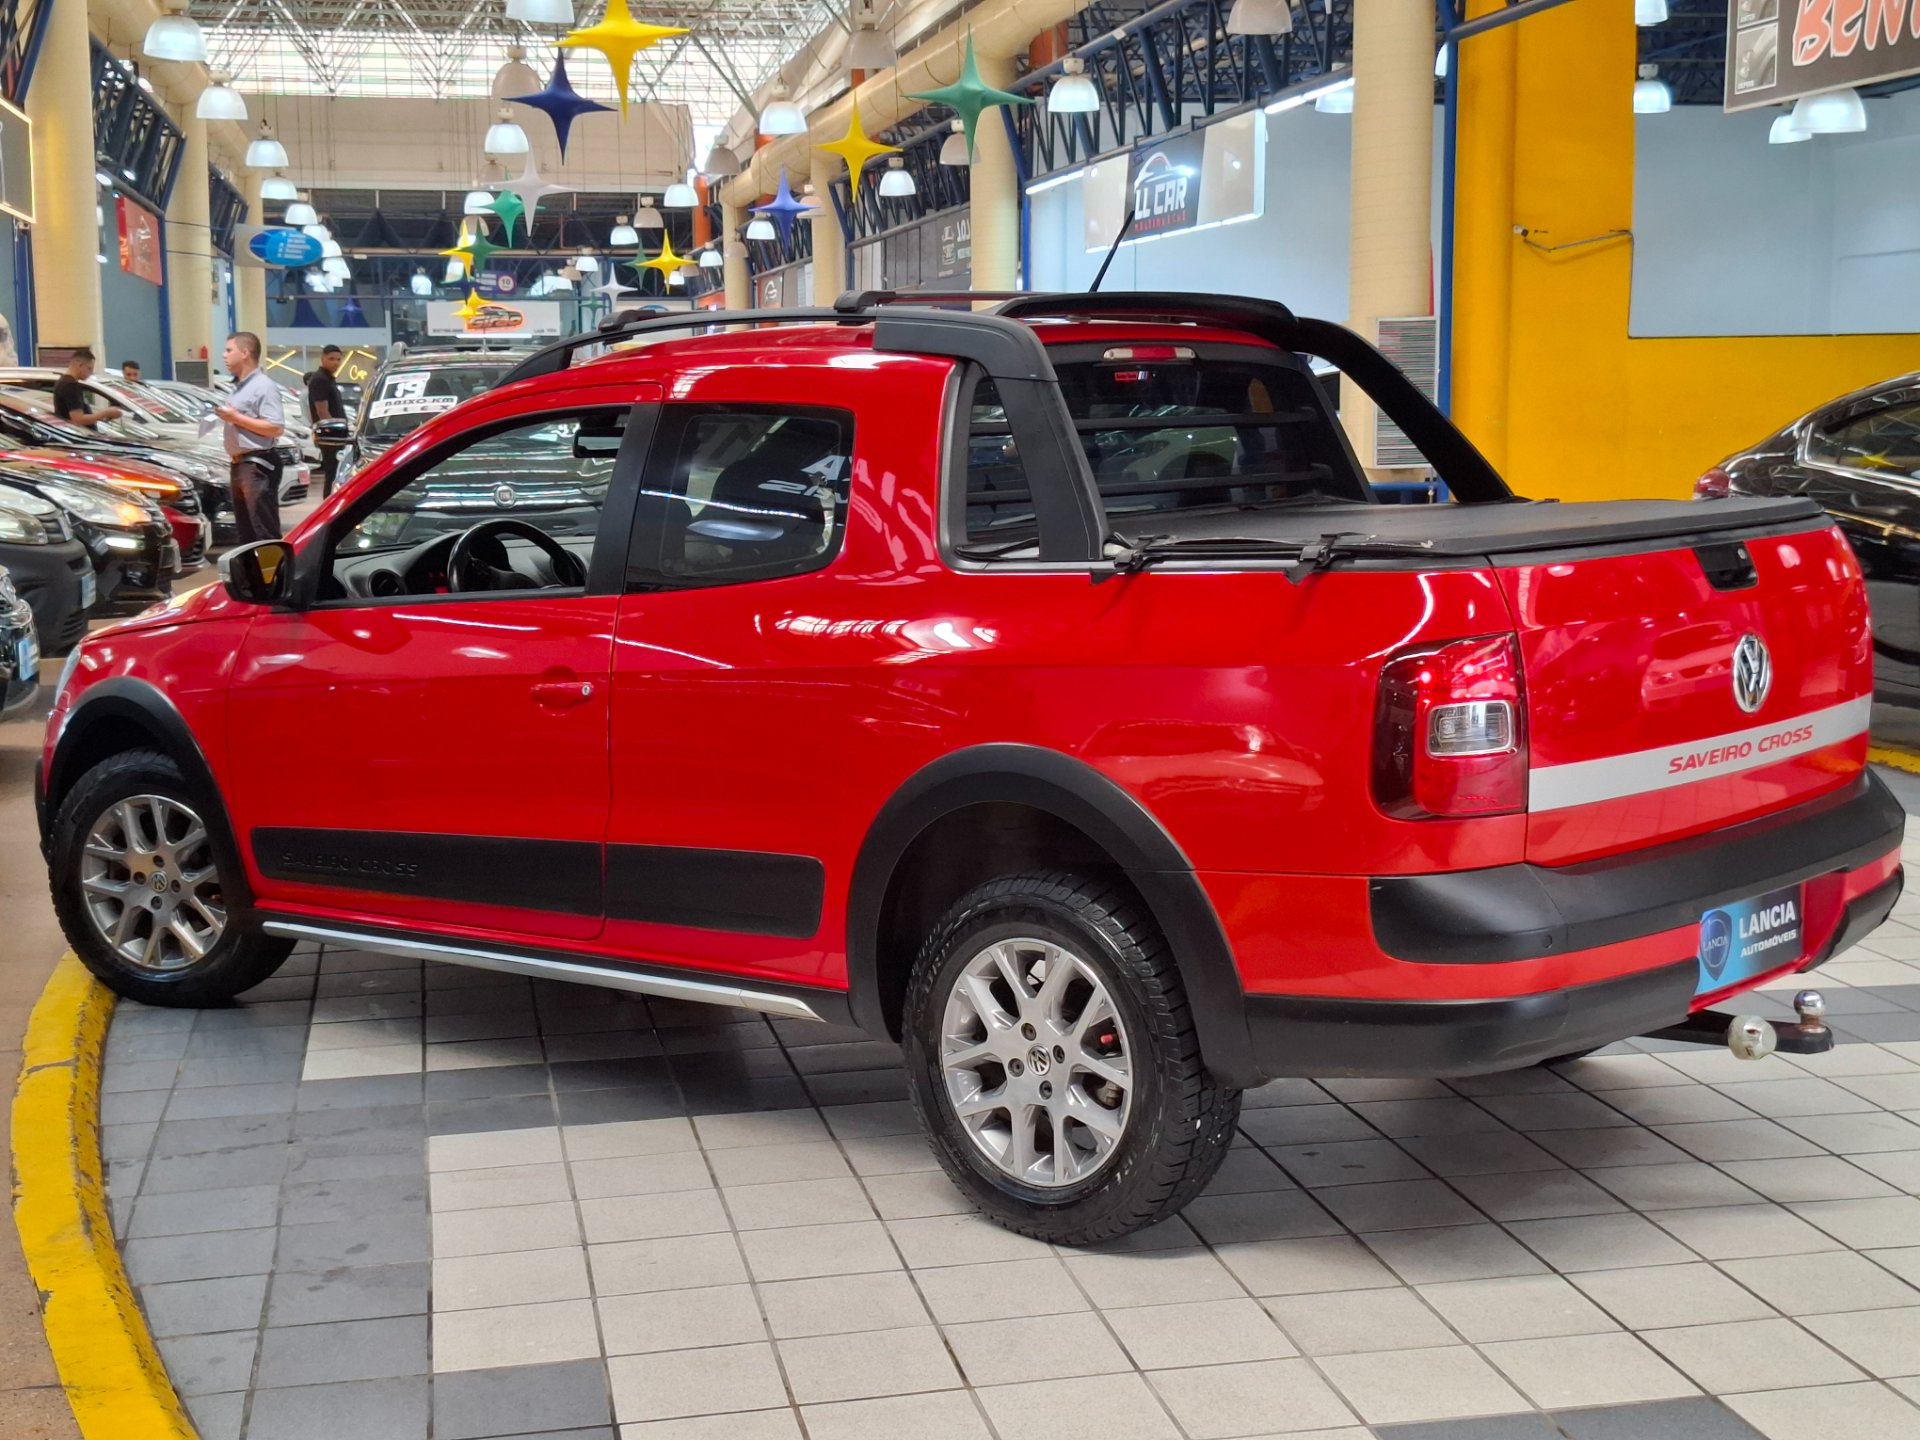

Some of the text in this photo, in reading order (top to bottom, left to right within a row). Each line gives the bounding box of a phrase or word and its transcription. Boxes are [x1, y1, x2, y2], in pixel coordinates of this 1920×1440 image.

[1134, 176, 1188, 220] LL CAR
[1667, 724, 1814, 775] SAVEIRO CROSS
[359, 859, 419, 877] CROSS
[1738, 900, 1797, 939] LANCIA
[1703, 935, 1728, 952] LANCIA
[1740, 928, 1798, 958] AUTOMÓVEIS
